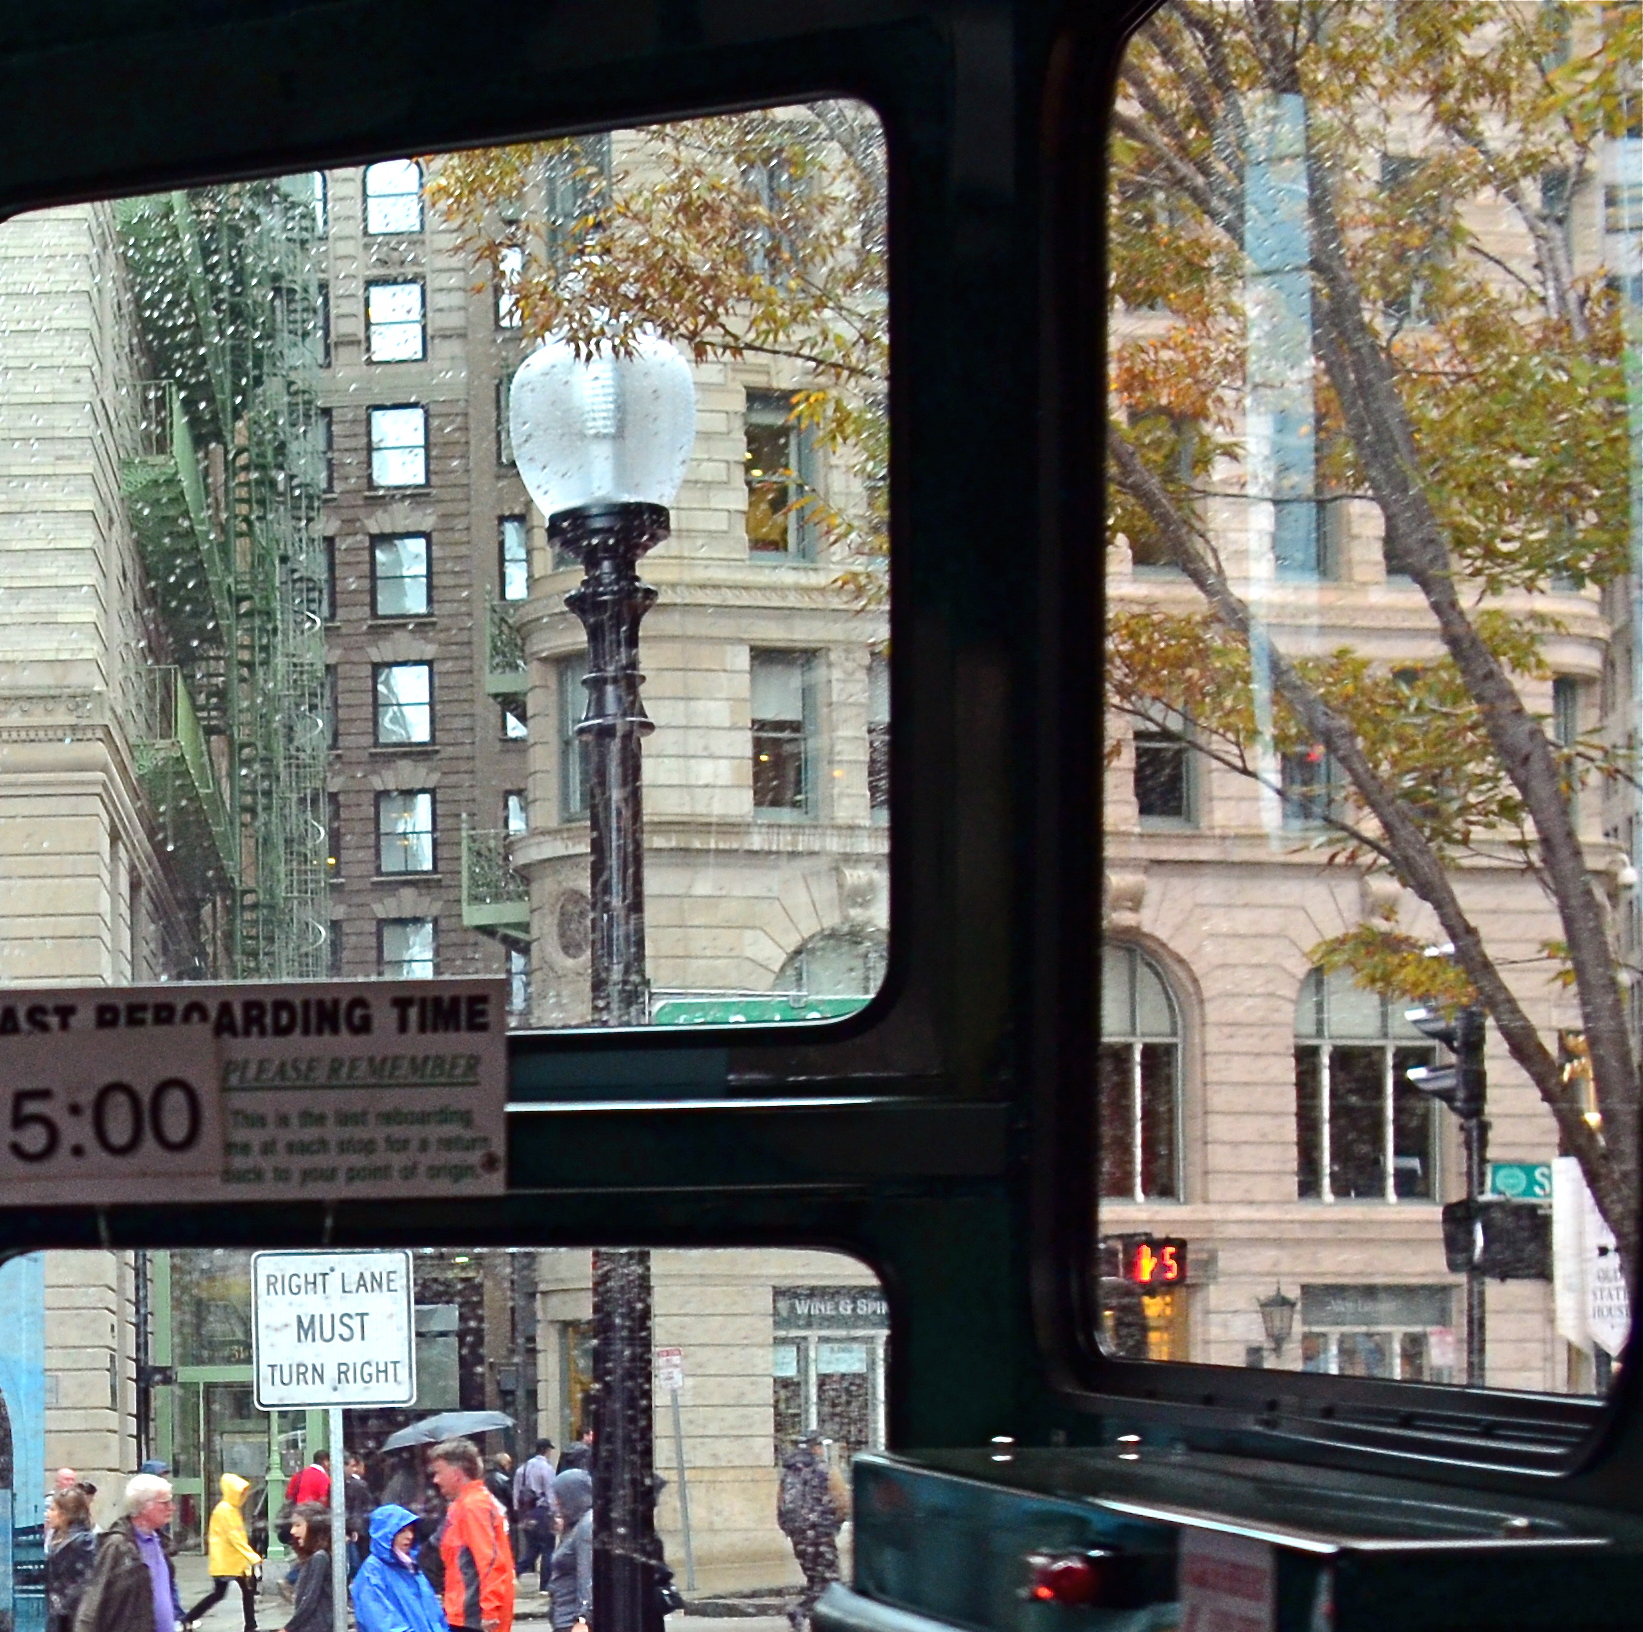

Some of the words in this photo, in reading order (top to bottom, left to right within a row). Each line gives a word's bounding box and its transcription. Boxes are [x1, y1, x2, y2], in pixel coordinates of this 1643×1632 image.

[390, 994, 490, 1035] TIME
[222, 1056, 319, 1085] PLEASE
[326, 1053, 482, 1082] REMEMBER
[9, 1076, 202, 1162] 5:00
[1163, 1246, 1178, 1280] 5
[266, 1272, 330, 1296] RIGHT
[341, 1271, 398, 1294] LANE
[795, 1300, 836, 1315] WINE
[296, 1312, 369, 1343] MUST
[267, 1363, 325, 1386] TURN
[337, 1360, 401, 1384] RIGHT
